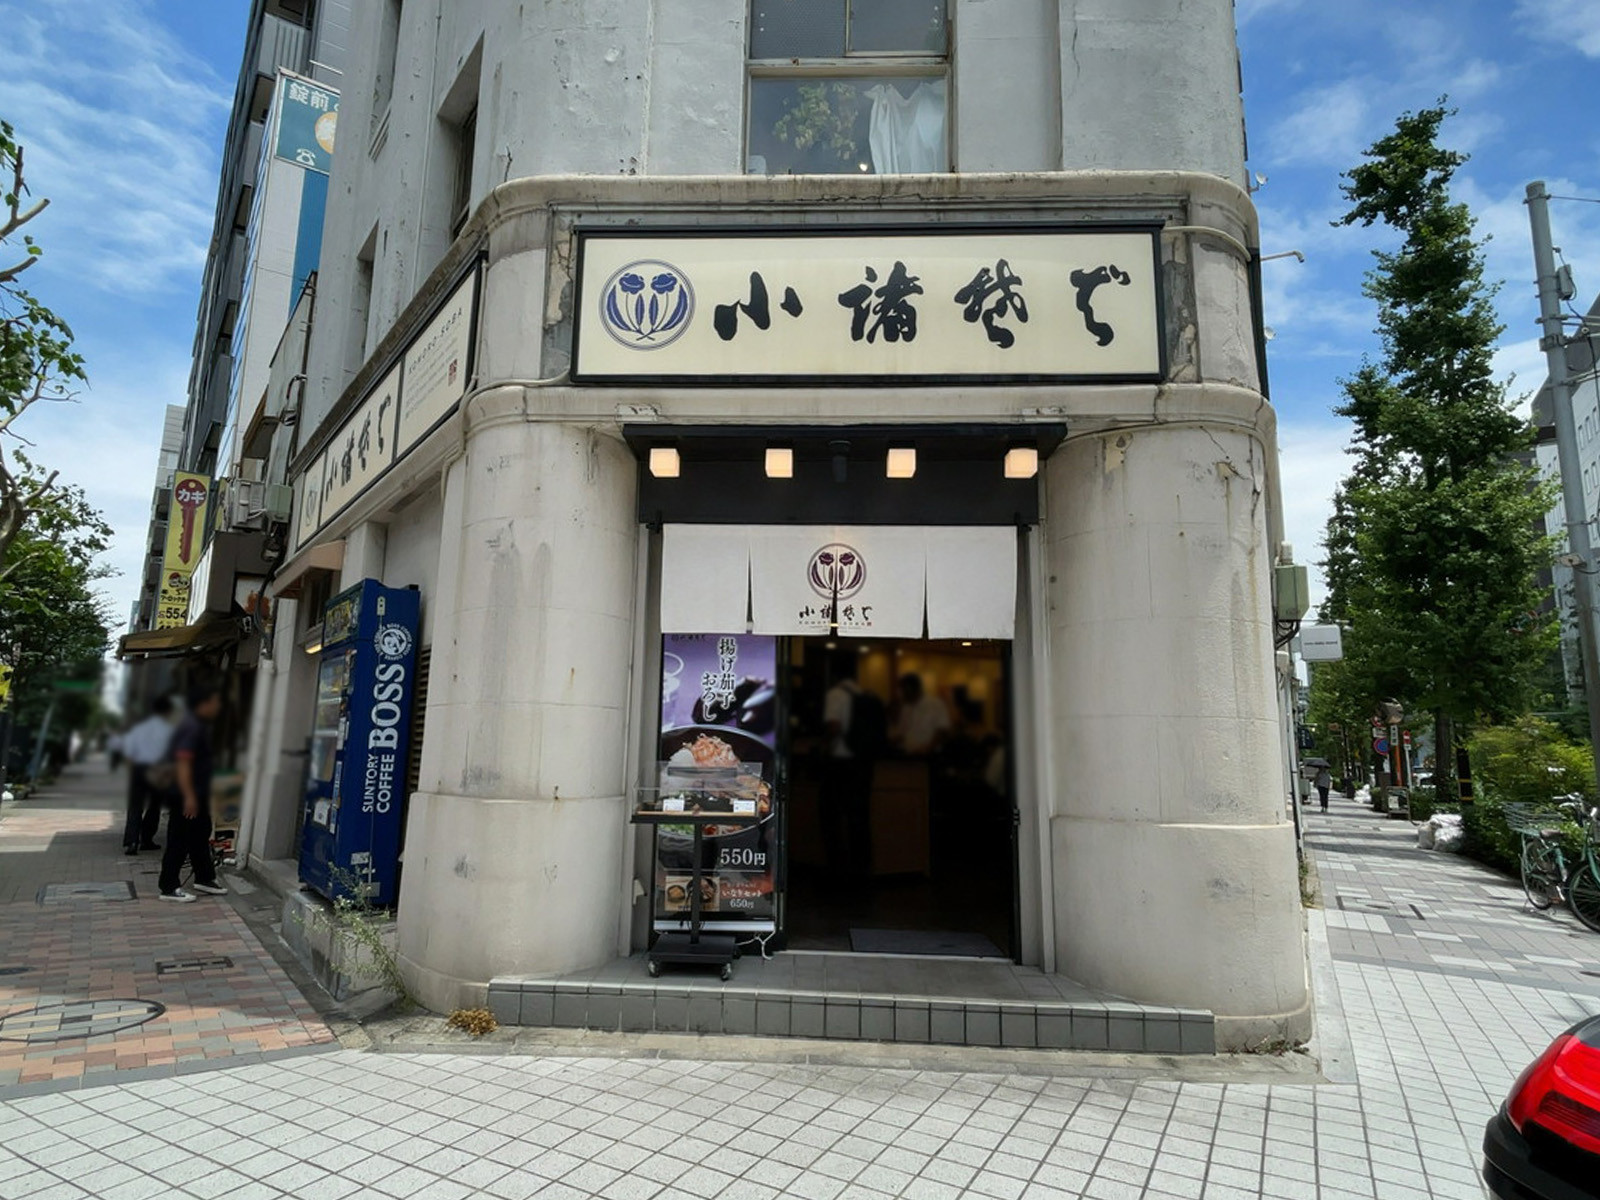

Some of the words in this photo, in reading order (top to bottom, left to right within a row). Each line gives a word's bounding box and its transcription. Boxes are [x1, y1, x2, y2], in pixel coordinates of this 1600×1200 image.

[178, 488, 206, 505] カギ
[701, 670, 718, 721] おろし
[717, 636, 738, 710] 揚げ茄子
[369, 663, 405, 750] BOSS
[362, 754, 379, 813] SUNTORY
[376, 754, 395, 813] COFFEE
[720, 848, 766, 866] 550円
[730, 898, 754, 909] 650円
